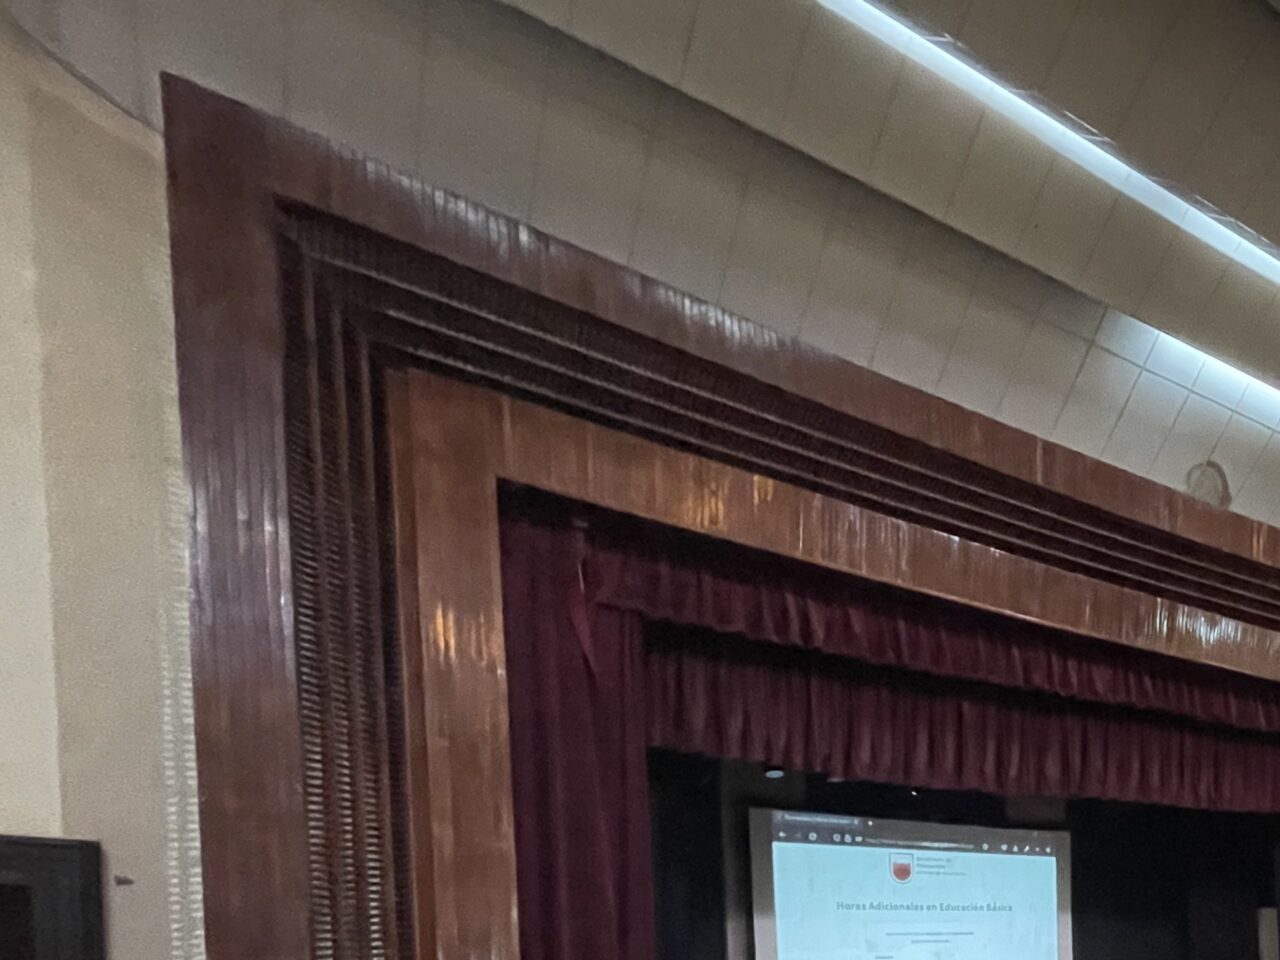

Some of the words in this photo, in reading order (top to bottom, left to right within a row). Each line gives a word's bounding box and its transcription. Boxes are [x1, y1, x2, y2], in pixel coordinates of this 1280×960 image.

[836, 901, 867, 911] Horas
[868, 901, 924, 912] Adicionales
[926, 904, 937, 912] en
[939, 902, 985, 912] Educación
